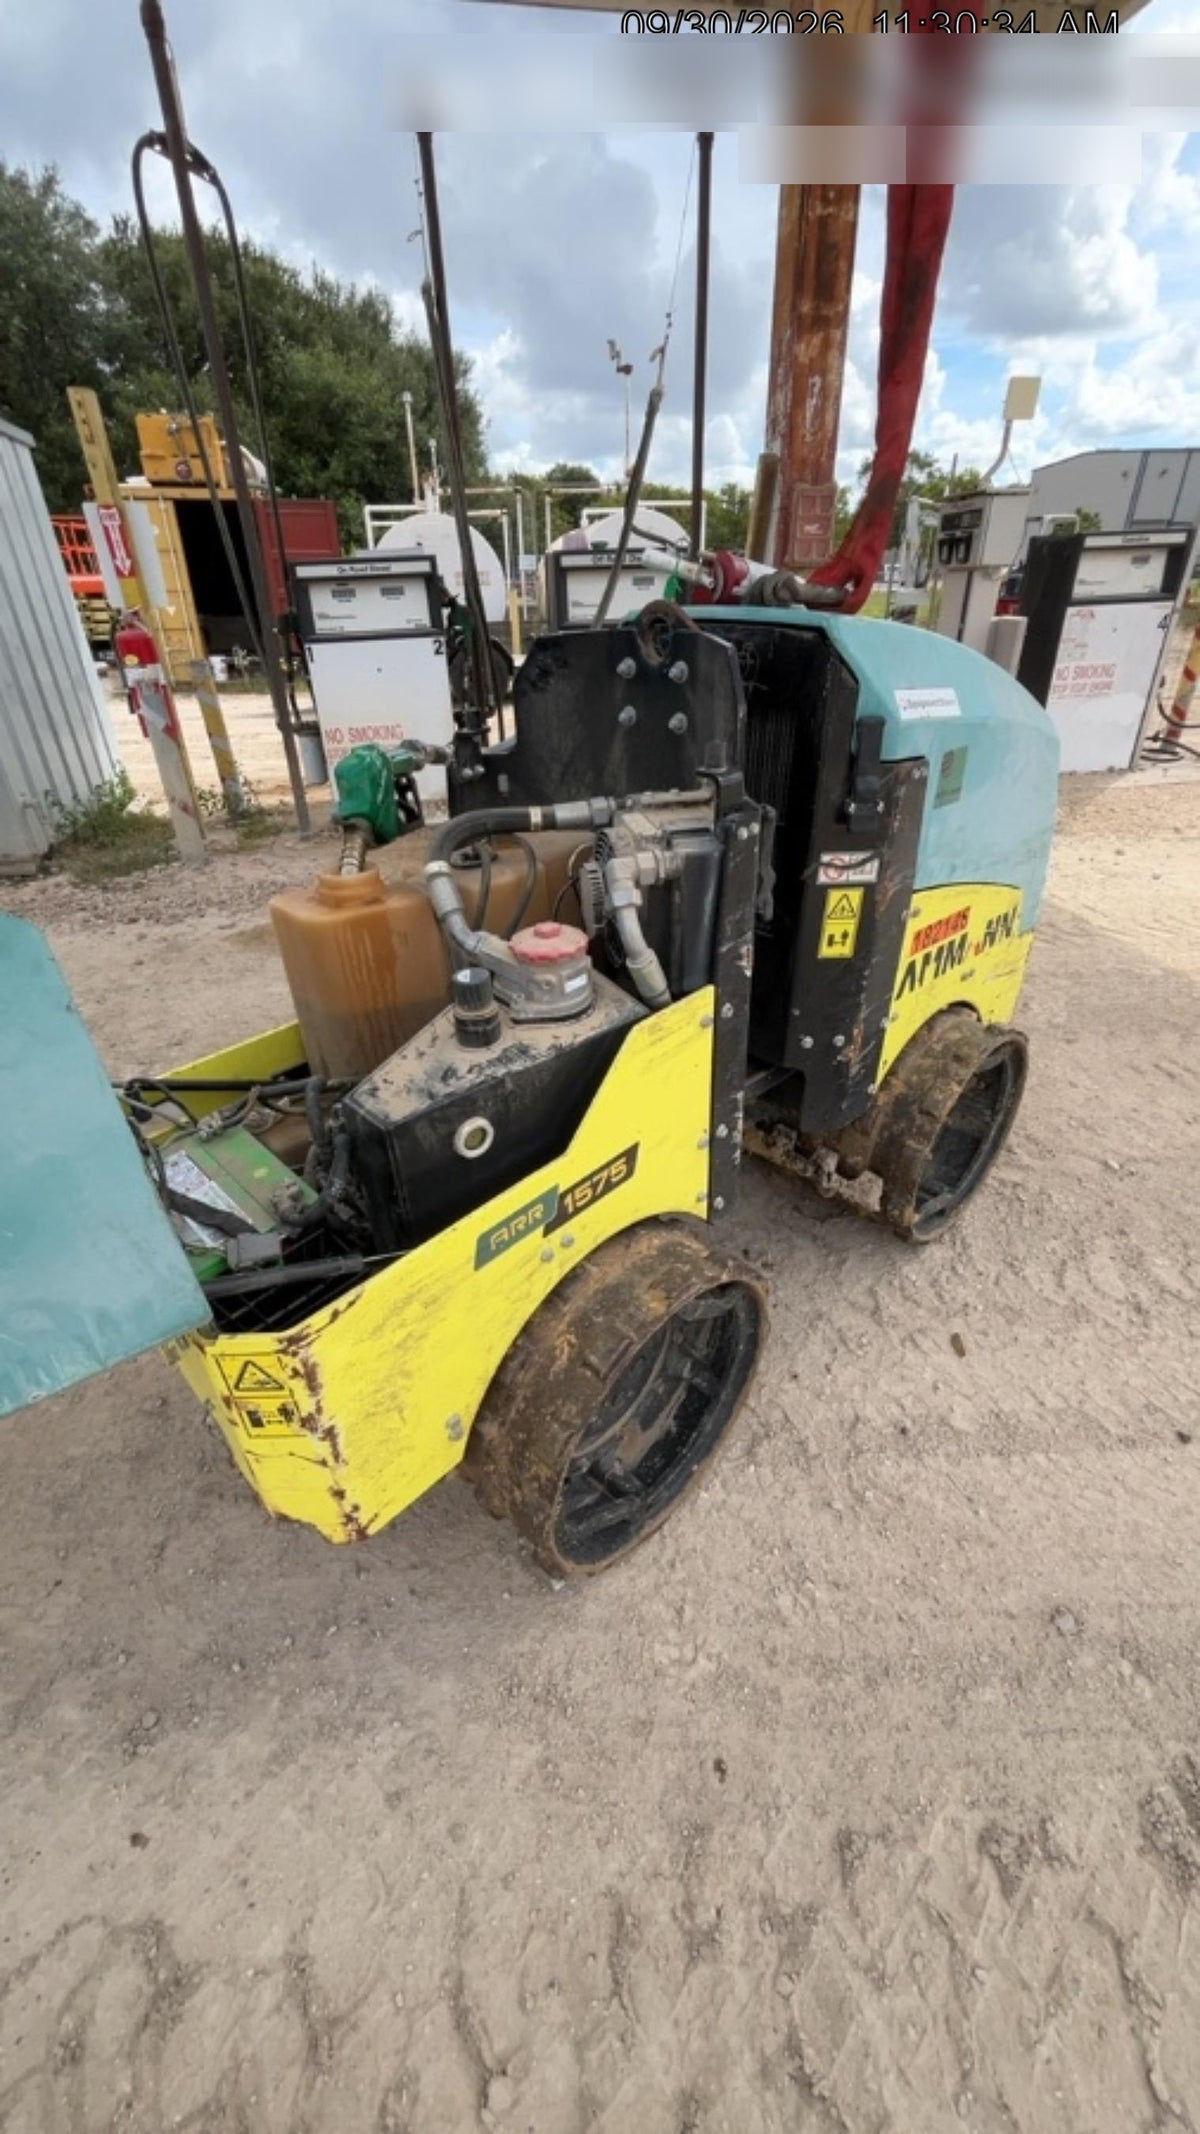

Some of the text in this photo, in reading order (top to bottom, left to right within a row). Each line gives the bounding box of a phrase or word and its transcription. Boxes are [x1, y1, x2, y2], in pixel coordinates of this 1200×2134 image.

[433, 640, 444, 655] 2
[1055, 663, 1116, 681] NO SMOKING
[324, 724, 404, 745] NO SMOKING
[490, 1157, 627, 1250] ARR 1575
